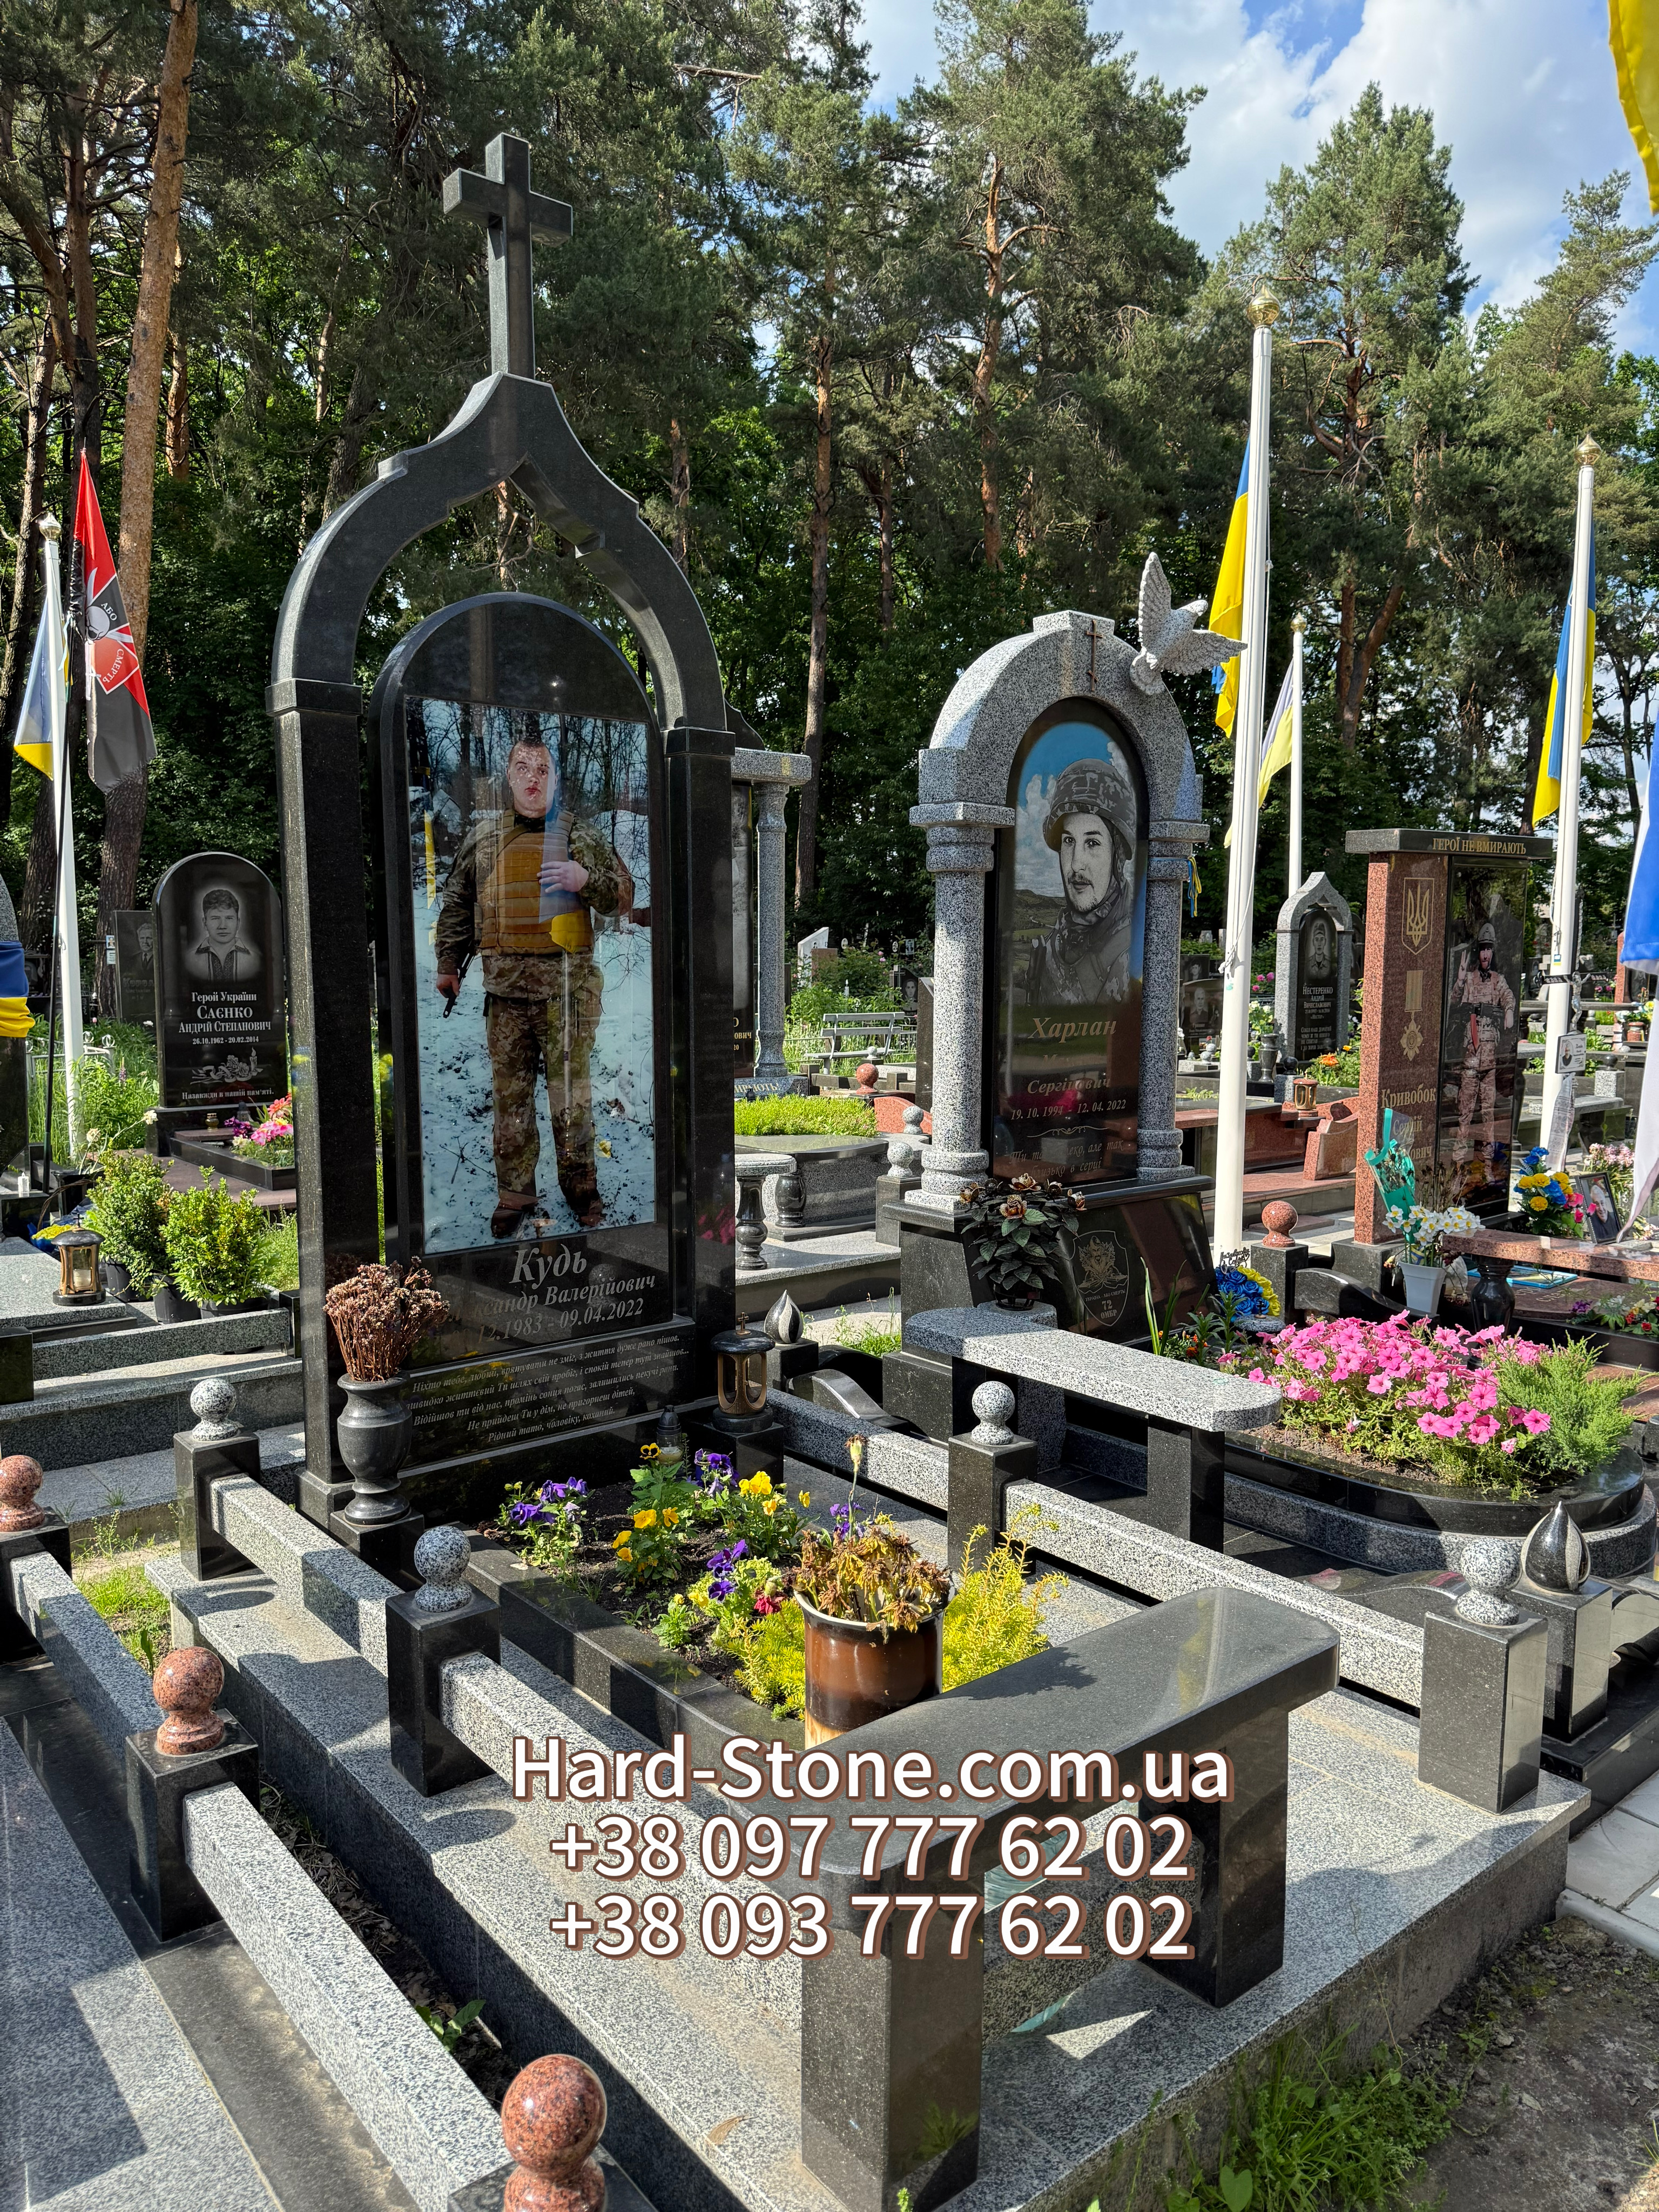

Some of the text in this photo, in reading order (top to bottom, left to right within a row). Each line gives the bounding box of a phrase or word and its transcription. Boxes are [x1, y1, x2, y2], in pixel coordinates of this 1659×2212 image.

[100, 602, 117, 621] АБО
[102, 649, 124, 683] СМЕРТЬ
[1432, 837, 1527, 854] ГЕРОЇ НЕ ВМИРАЮТЬ
[191, 992, 257, 1004] Герой України
[197, 1005, 253, 1019] САЄНКО
[178, 1021, 271, 1034] АНДРІЙ СТЕПАНОВИЧ
[1027, 1017, 1117, 1043] Харлан
[192, 1037, 225, 1045] 26.10.1962
[1380, 1083, 1437, 1108] Кривобок
[1010, 1109, 1024, 1121] 19.
[1026, 1108, 1040, 1120] 10.
[1042, 1105, 1064, 1118] 1994
[1077, 1103, 1089, 1114] 12.
[1091, 1101, 1104, 1112] 04.
[1107, 1099, 1127, 1111] 2022
[1393, 1115, 1424, 1136] Сеій
[1088, 1143, 1102, 1154] але
[1107, 1139, 1124, 1151] так
[1080, 1157, 1102, 1174] серці
[509, 1243, 588, 1290] Кудь
[543, 1274, 656, 1307] Валерійович
[559, 1298, 644, 1330] 09.04.2022
[1100, 1309, 1117, 1319] ОМБР
[1101, 1299, 1113, 1311] 72
[412, 1381, 442, 1393] Ніхто
[443, 1375, 467, 1387] тебе,
[469, 1367, 499, 1382] любий,
[501, 1360, 547, 1378] врятувати
[549, 1358, 558, 1366] не
[559, 1353, 577, 1365] зміг,
[584, 1346, 616, 1359] життя
[617, 1343, 637, 1354] дуже
[637, 1339, 656, 1351] рано
[656, 1335, 680, 1345] пішов.
[446, 1384, 496, 1402] життєвий
[497, 1382, 509, 1392] Ти
[510, 1379, 532, 1390] шлях
[534, 1374, 550, 1385] свій
[551, 1369, 578, 1383] пробіг,
[579, 1366, 583, 1375] і
[584, 1362, 609, 1375] спокій
[610, 1357, 634, 1369] тепер
[635, 1354, 652, 1365] тут
[413, 1364, 679, 1426] Відійшов ти від нас, промінь сонця погас, залишились пекучі рани.
[467, 1387, 636, 1431] Не прийдеш Ти у дім, не пригорнеш дітей,
[488, 1406, 615, 1442] Рідний тато, чоловіку, коханий.
